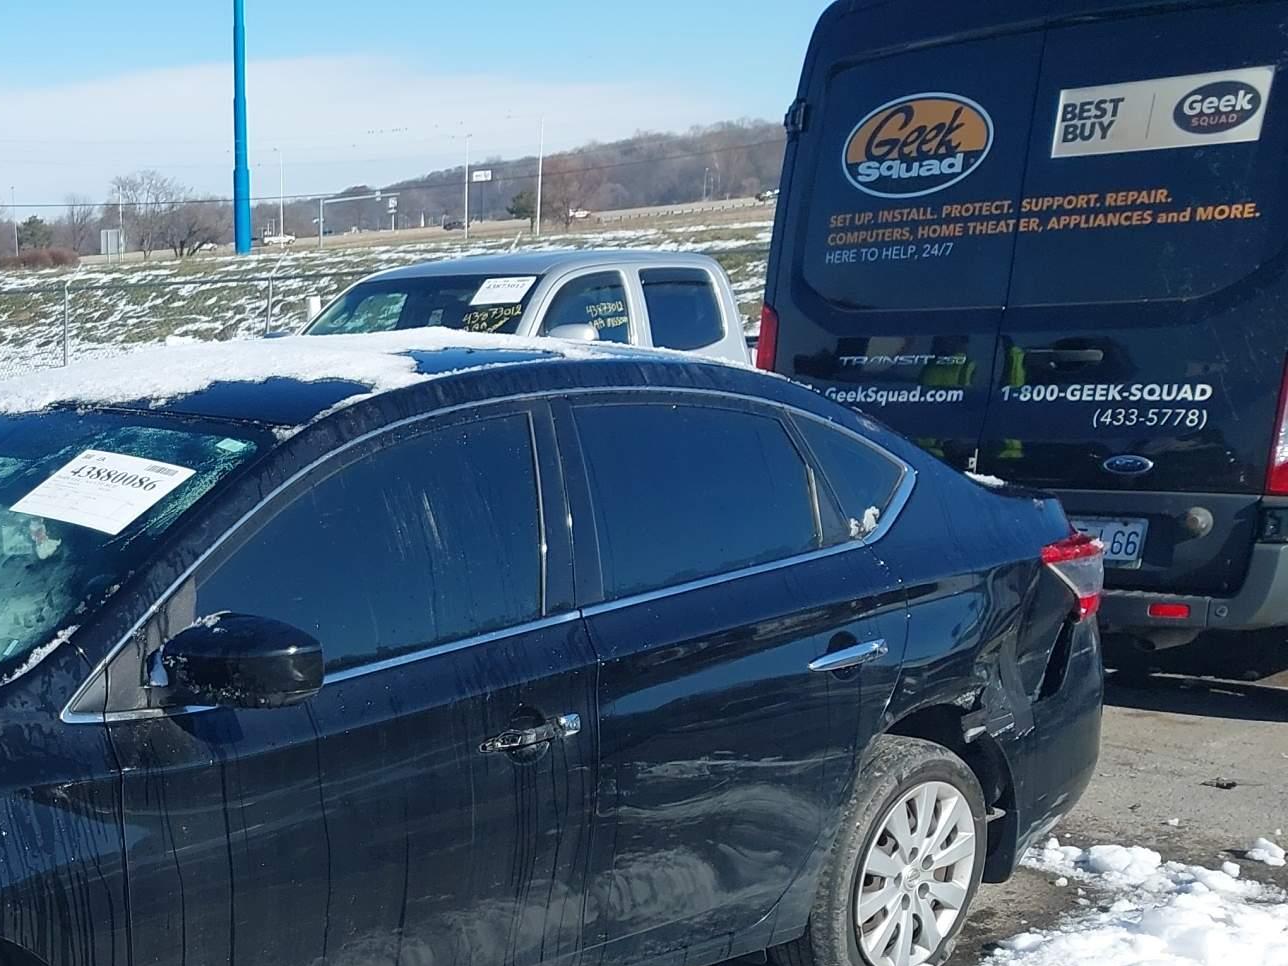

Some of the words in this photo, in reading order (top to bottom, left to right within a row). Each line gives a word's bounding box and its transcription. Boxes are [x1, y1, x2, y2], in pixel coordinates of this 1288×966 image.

[1062, 97, 1124, 122] BEST
[1183, 90, 1254, 116] Geek
[1062, 120, 1115, 143] BUY
[1191, 113, 1238, 127] SQUAD
[864, 105, 965, 160] Geek
[857, 152, 964, 182] squad
[829, 213, 853, 228] SET
[855, 210, 875, 225] UP.
[878, 205, 938, 223] INSTALL.
[942, 200, 1013, 218] PROTECT.
[1021, 193, 1101, 213] SUPPORT.
[1105, 188, 1173, 207] REPAIR.
[827, 226, 914, 246] COMPUTERS,
[917, 222, 963, 239] HOME
[1047, 210, 1153, 230] APPLIANCES
[1157, 208, 1191, 223] and
[1196, 202, 1261, 221] MORE.
[825, 249, 857, 264] HERE
[861, 247, 879, 261] TO
[881, 244, 919, 261] HELP,
[922, 242, 954, 258] 24/7
[839, 355, 935, 366] TRANSIT
[825, 386, 964, 406] GeekSquad.com
[1001, 384, 1213, 401] 1-800-GEEK-SQUAD
[1092, 408, 1208, 430] (433-5778)
[70, 464, 158, 491] 43880086
